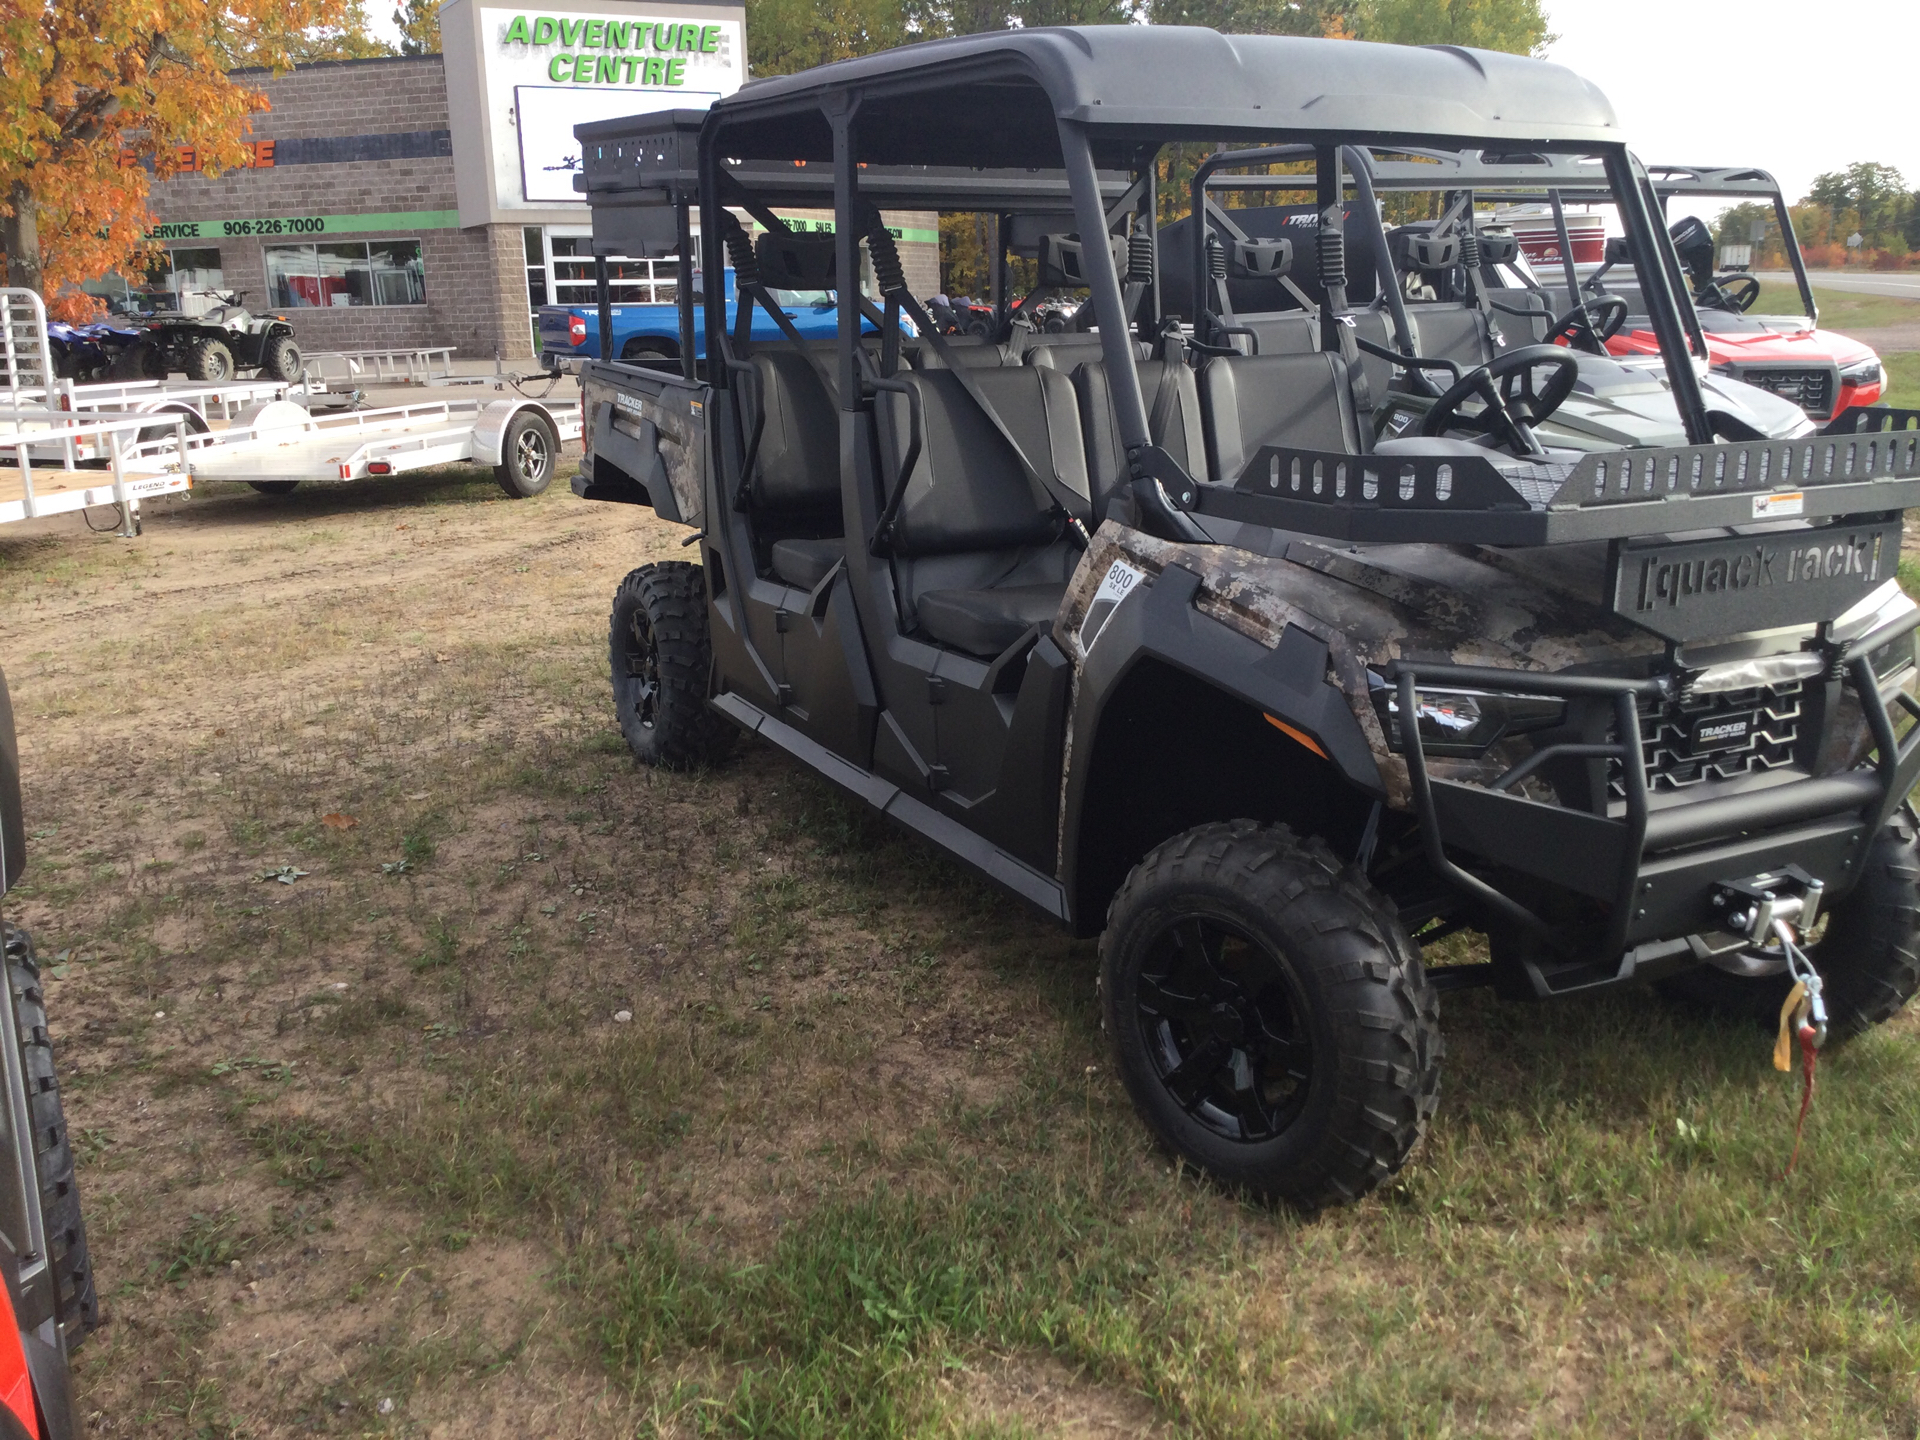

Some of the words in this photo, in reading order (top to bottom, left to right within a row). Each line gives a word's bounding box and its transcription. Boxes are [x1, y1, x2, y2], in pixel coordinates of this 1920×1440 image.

[504, 15, 722, 53] ADVENTURE
[549, 53, 687, 86] CENTRE
[223, 217, 325, 236] 906-226-7000
[617, 392, 643, 411] TRACKER
[1393, 413, 1409, 424] 800
[132, 481, 165, 491] LEGEND
[1109, 564, 1133, 589] 800
[1116, 588, 1125, 596] LE
[1700, 721, 1747, 738] TRACKER
